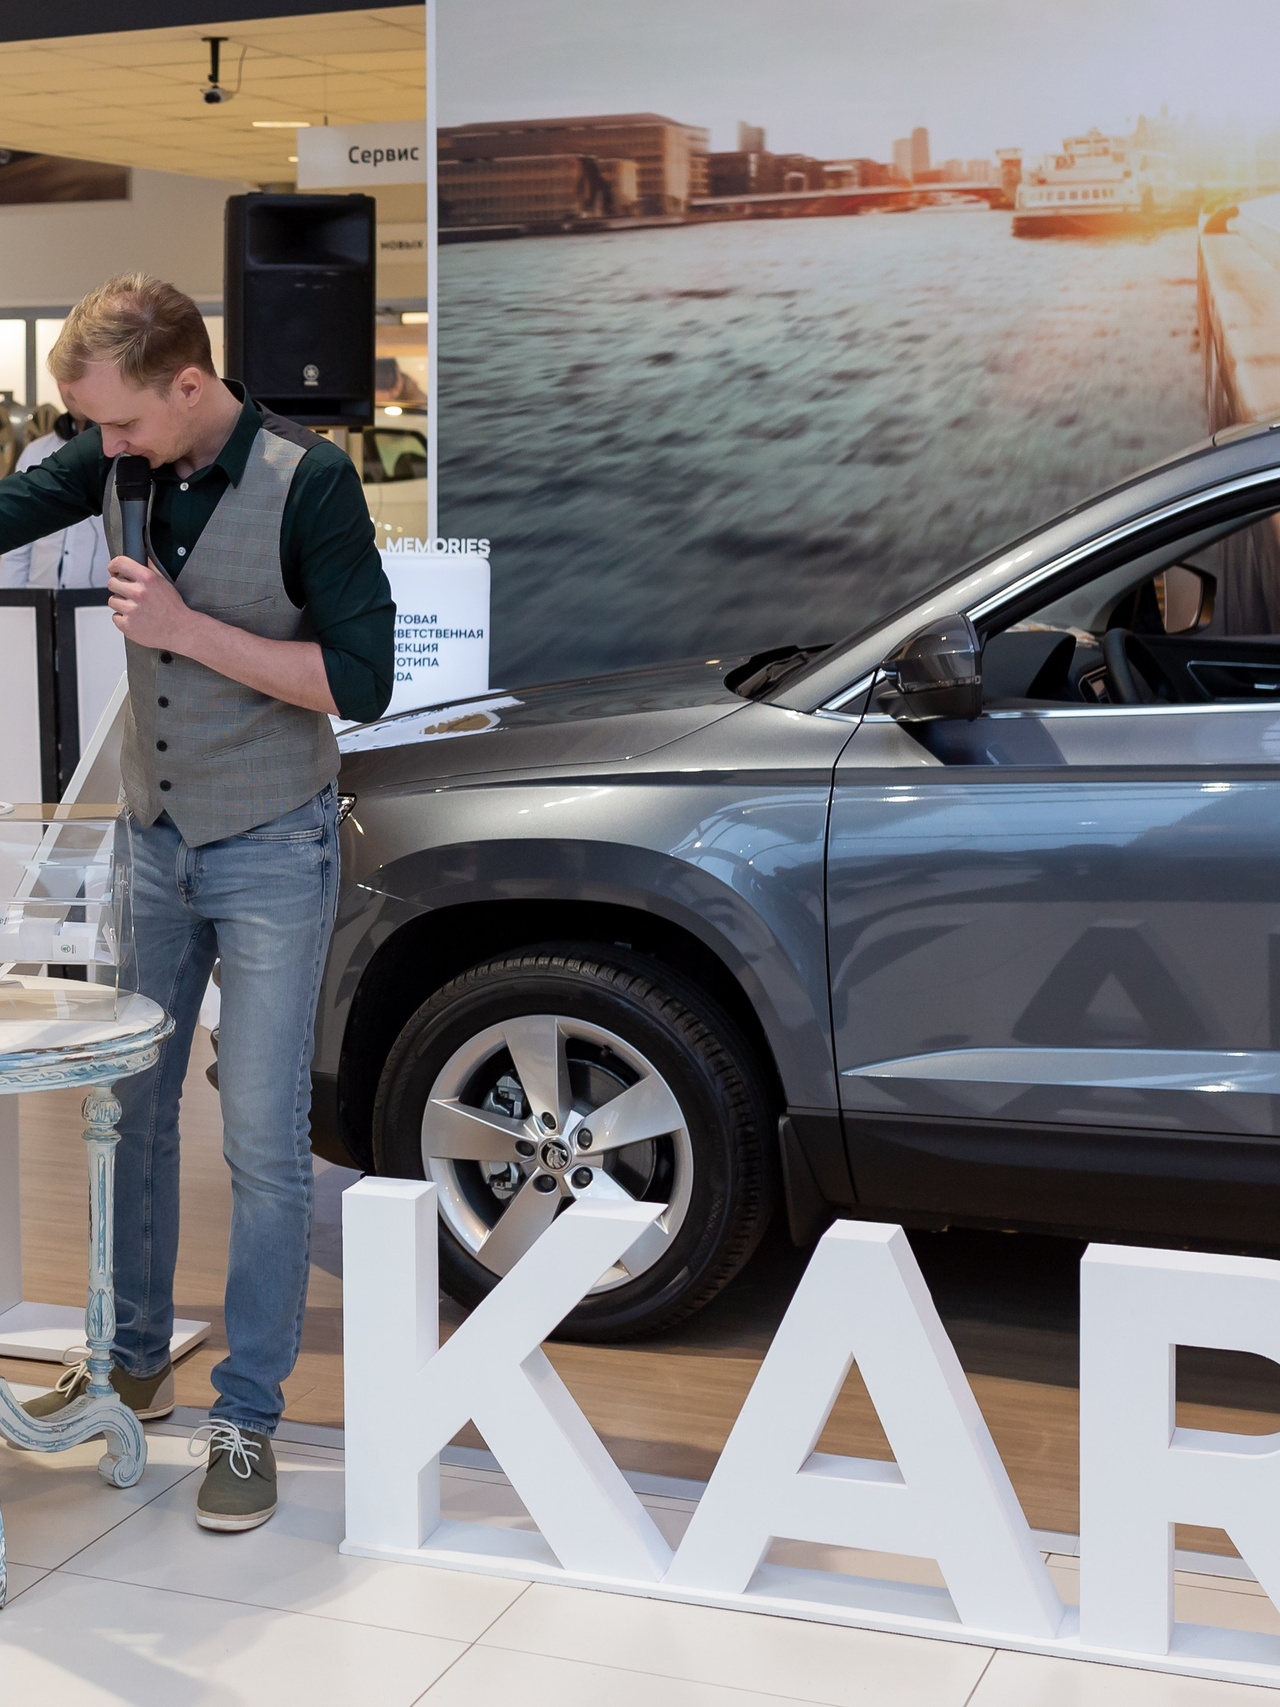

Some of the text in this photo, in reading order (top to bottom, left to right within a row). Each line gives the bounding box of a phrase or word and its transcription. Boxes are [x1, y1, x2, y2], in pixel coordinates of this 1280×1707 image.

[348, 146, 419, 167] Сервис
[386, 537, 491, 557] MEMORIES
[397, 614, 437, 625] ТОВАЯ
[394, 643, 439, 654] ЕКЦИЯ
[395, 657, 439, 667] ОТИПА
